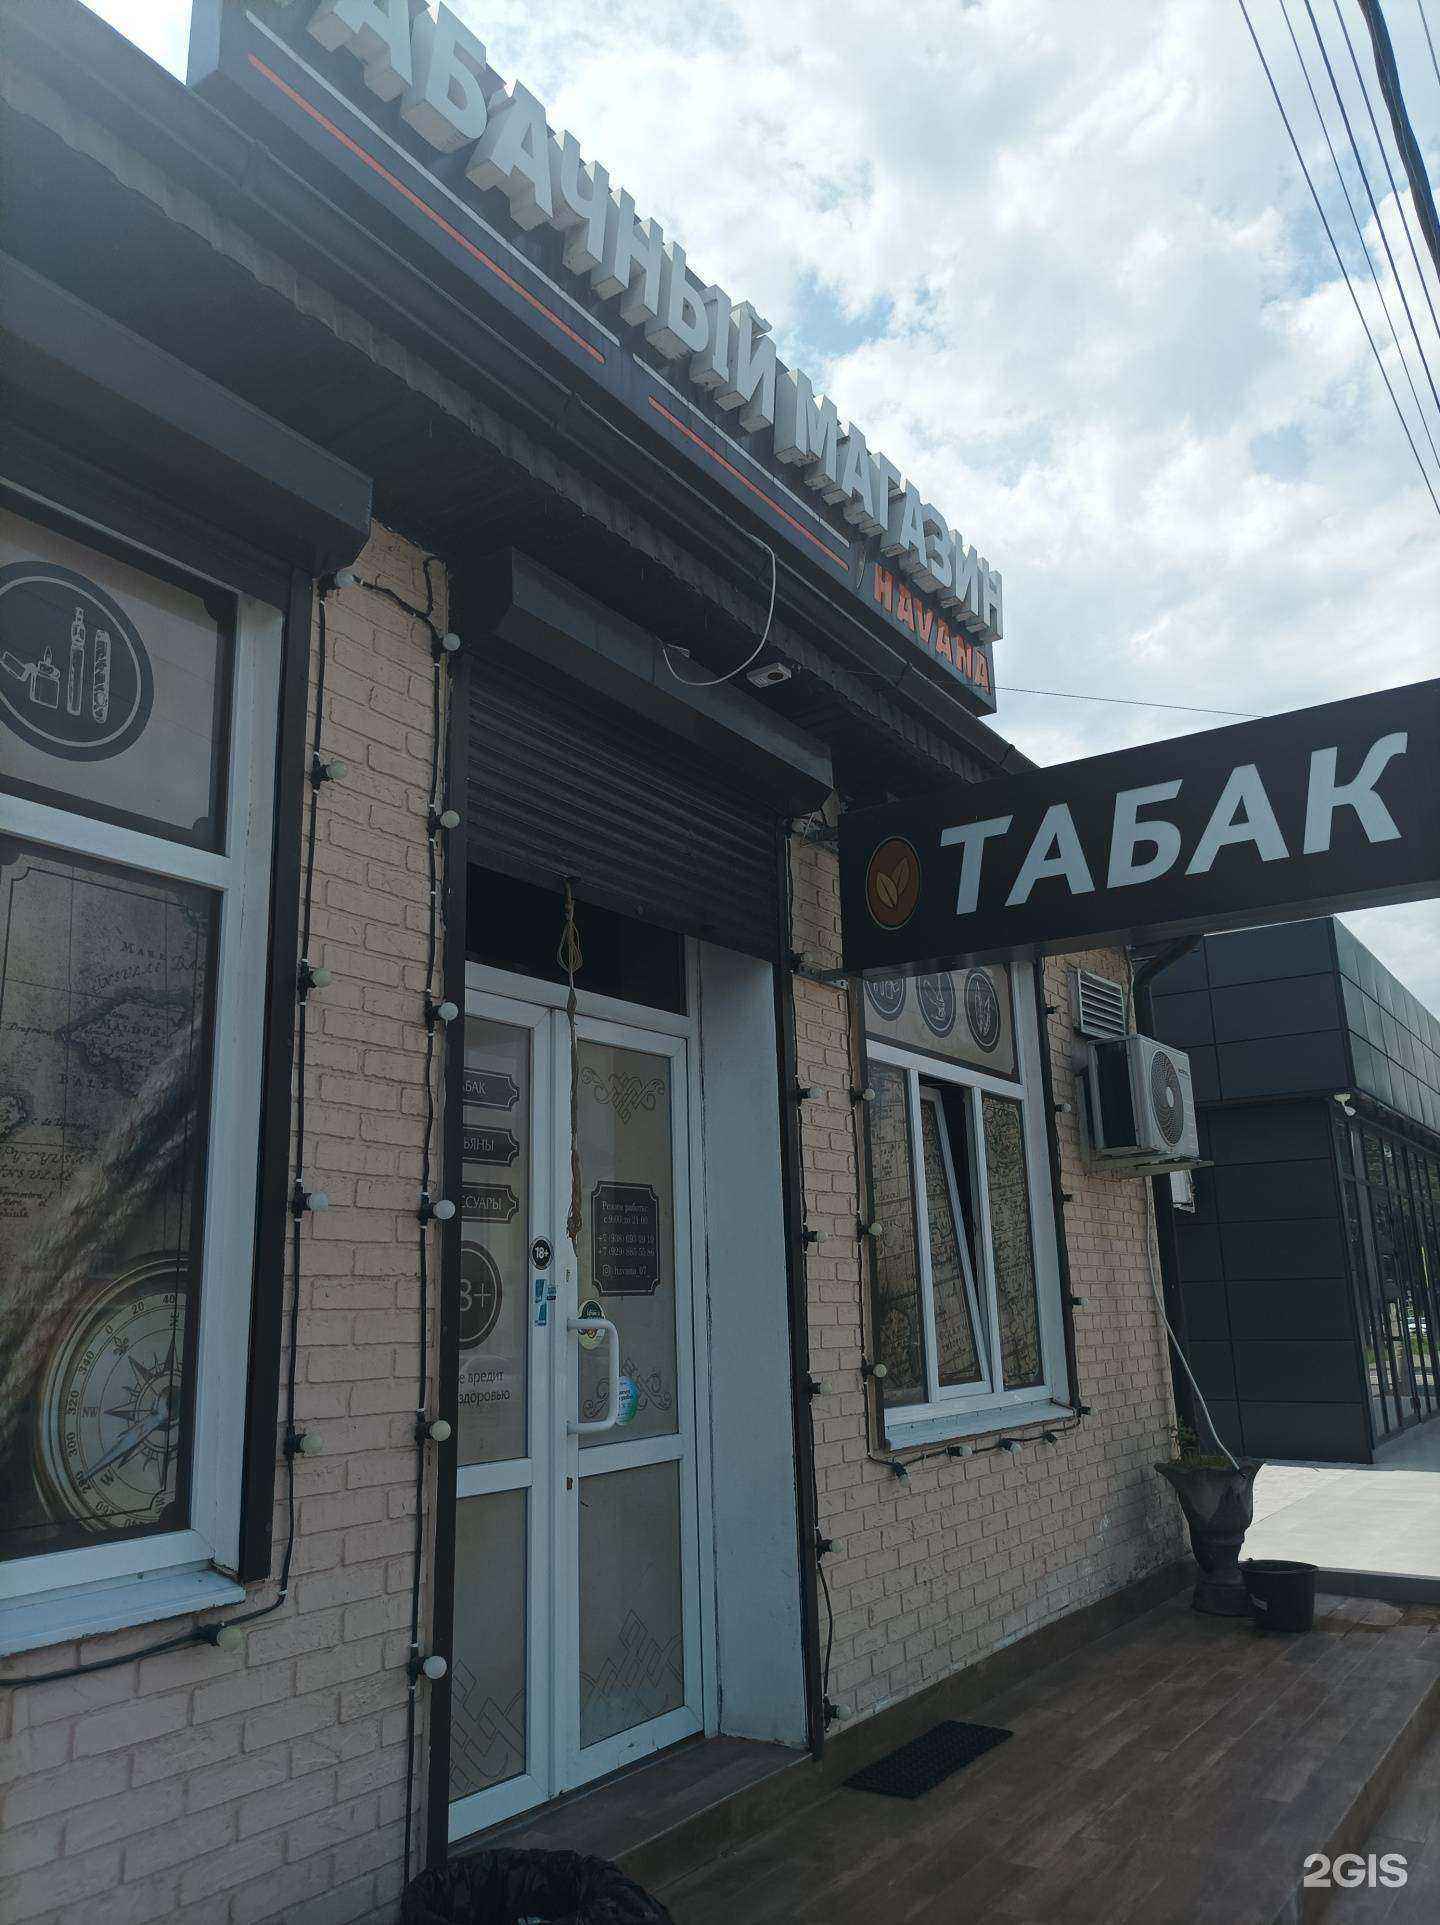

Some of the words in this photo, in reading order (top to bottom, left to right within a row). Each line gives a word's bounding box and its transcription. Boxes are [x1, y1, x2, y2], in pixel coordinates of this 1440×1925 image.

[774, 368, 1003, 643] МАГАЗИН
[873, 563, 992, 696] HAVANA
[939, 731, 1409, 916] ТАБАК
[463, 1080, 487, 1096] БАК
[535, 1247, 549, 1259] 18+
[131, 1300, 146, 1316] 20
[466, 1370, 504, 1386] вредит
[67, 1390, 80, 1416] 320
[81, 1406, 98, 1418] NW
[66, 1431, 78, 1457] 300
